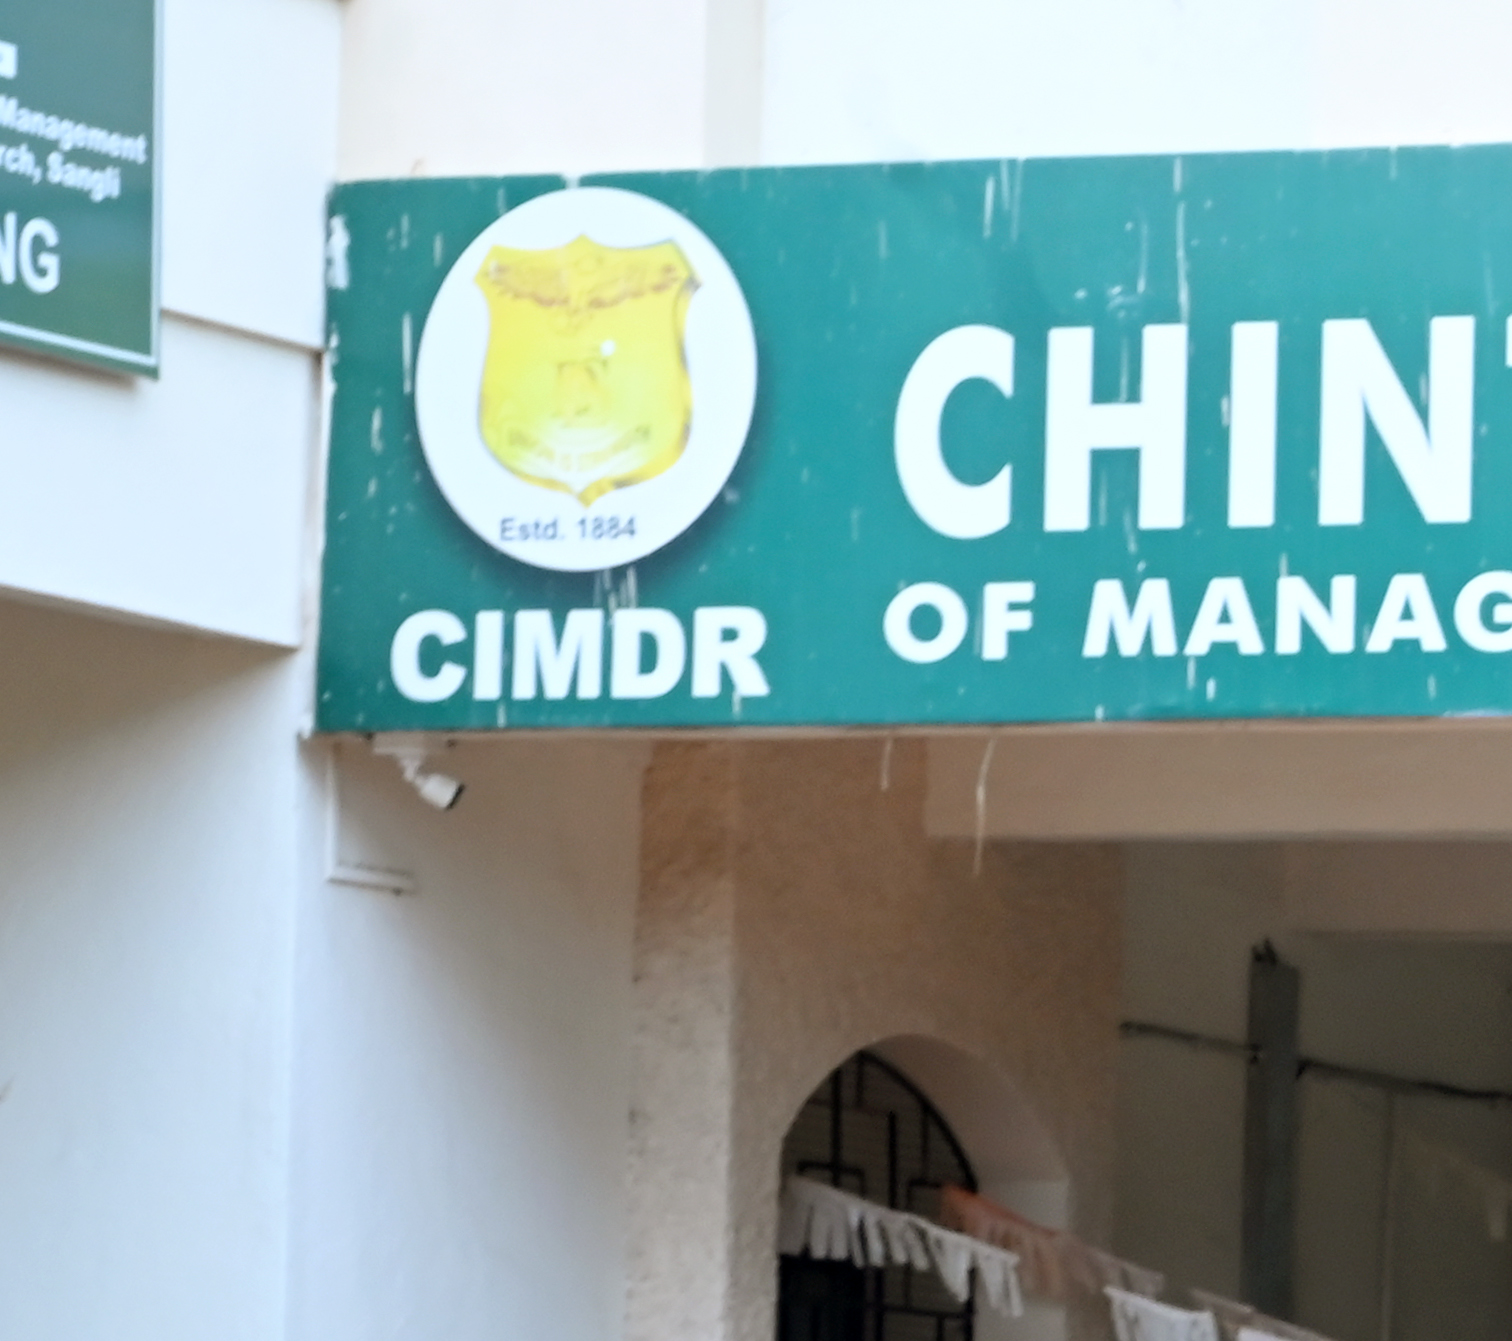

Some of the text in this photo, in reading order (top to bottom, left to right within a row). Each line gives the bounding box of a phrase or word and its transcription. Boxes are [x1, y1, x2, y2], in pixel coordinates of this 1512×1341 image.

[47, 151, 121, 202] Sangli
[500, 514, 637, 541] Estd. 1884
[884, 582, 1034, 662] OF
[392, 607, 769, 703] CIMDR
